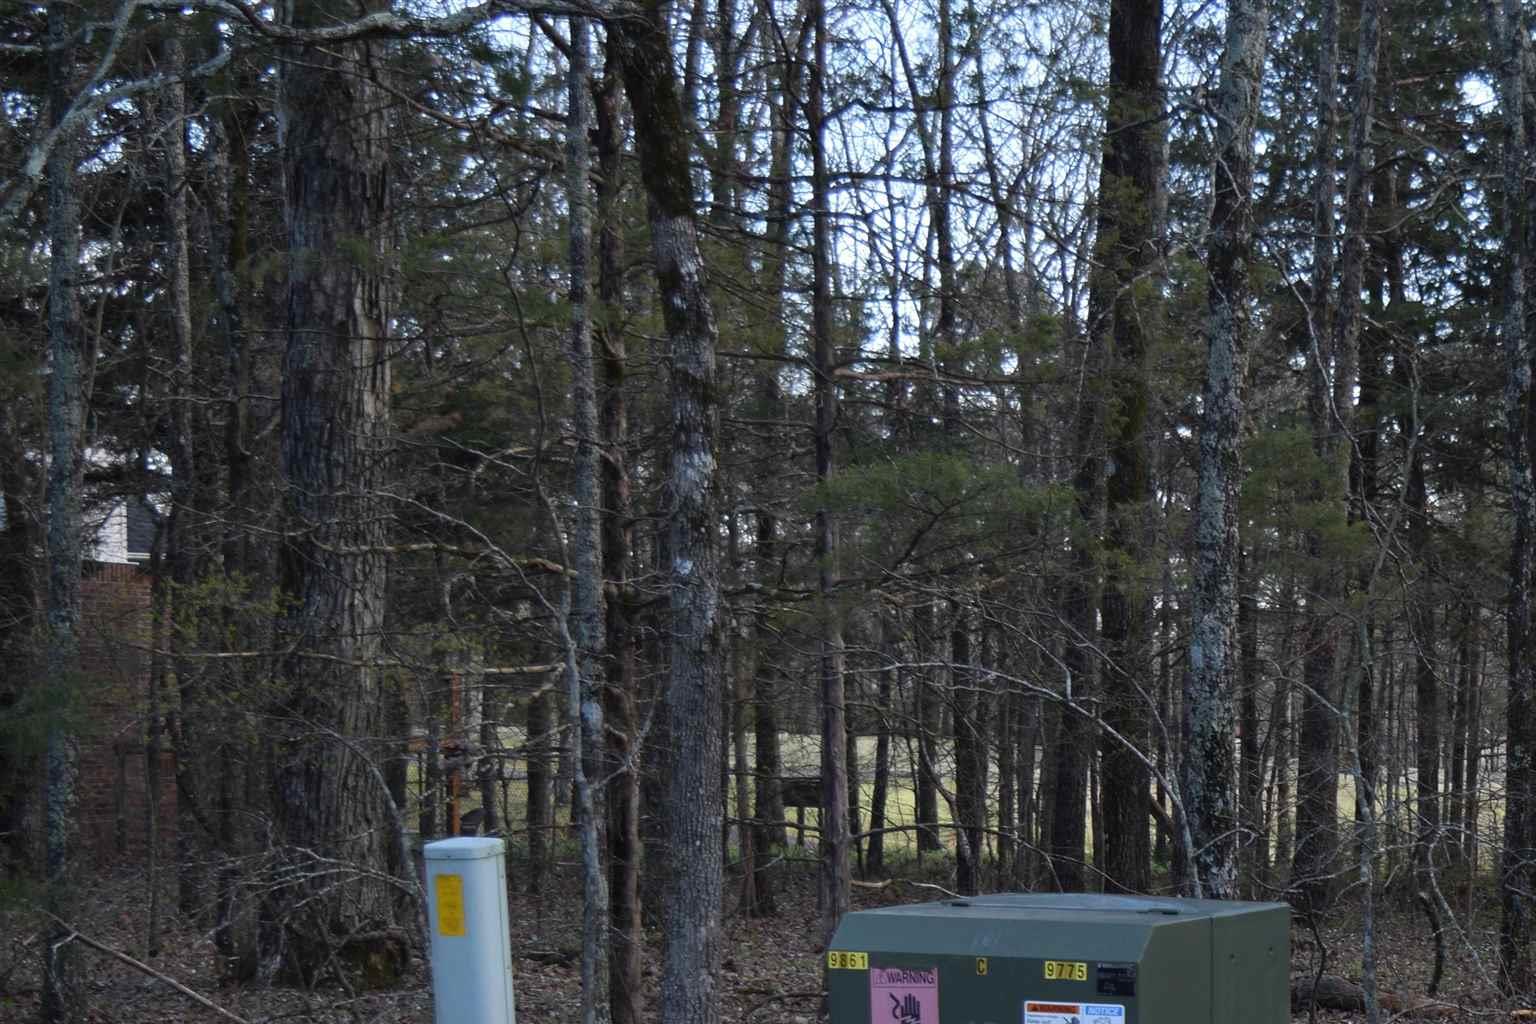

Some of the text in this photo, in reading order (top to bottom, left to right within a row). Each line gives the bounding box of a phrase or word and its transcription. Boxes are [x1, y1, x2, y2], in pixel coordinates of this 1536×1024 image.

[829, 953, 867, 968] 9861
[886, 970, 935, 986] WARNING
[1046, 963, 1086, 979] 9775
[1087, 1006, 1119, 1016] NOTICE
